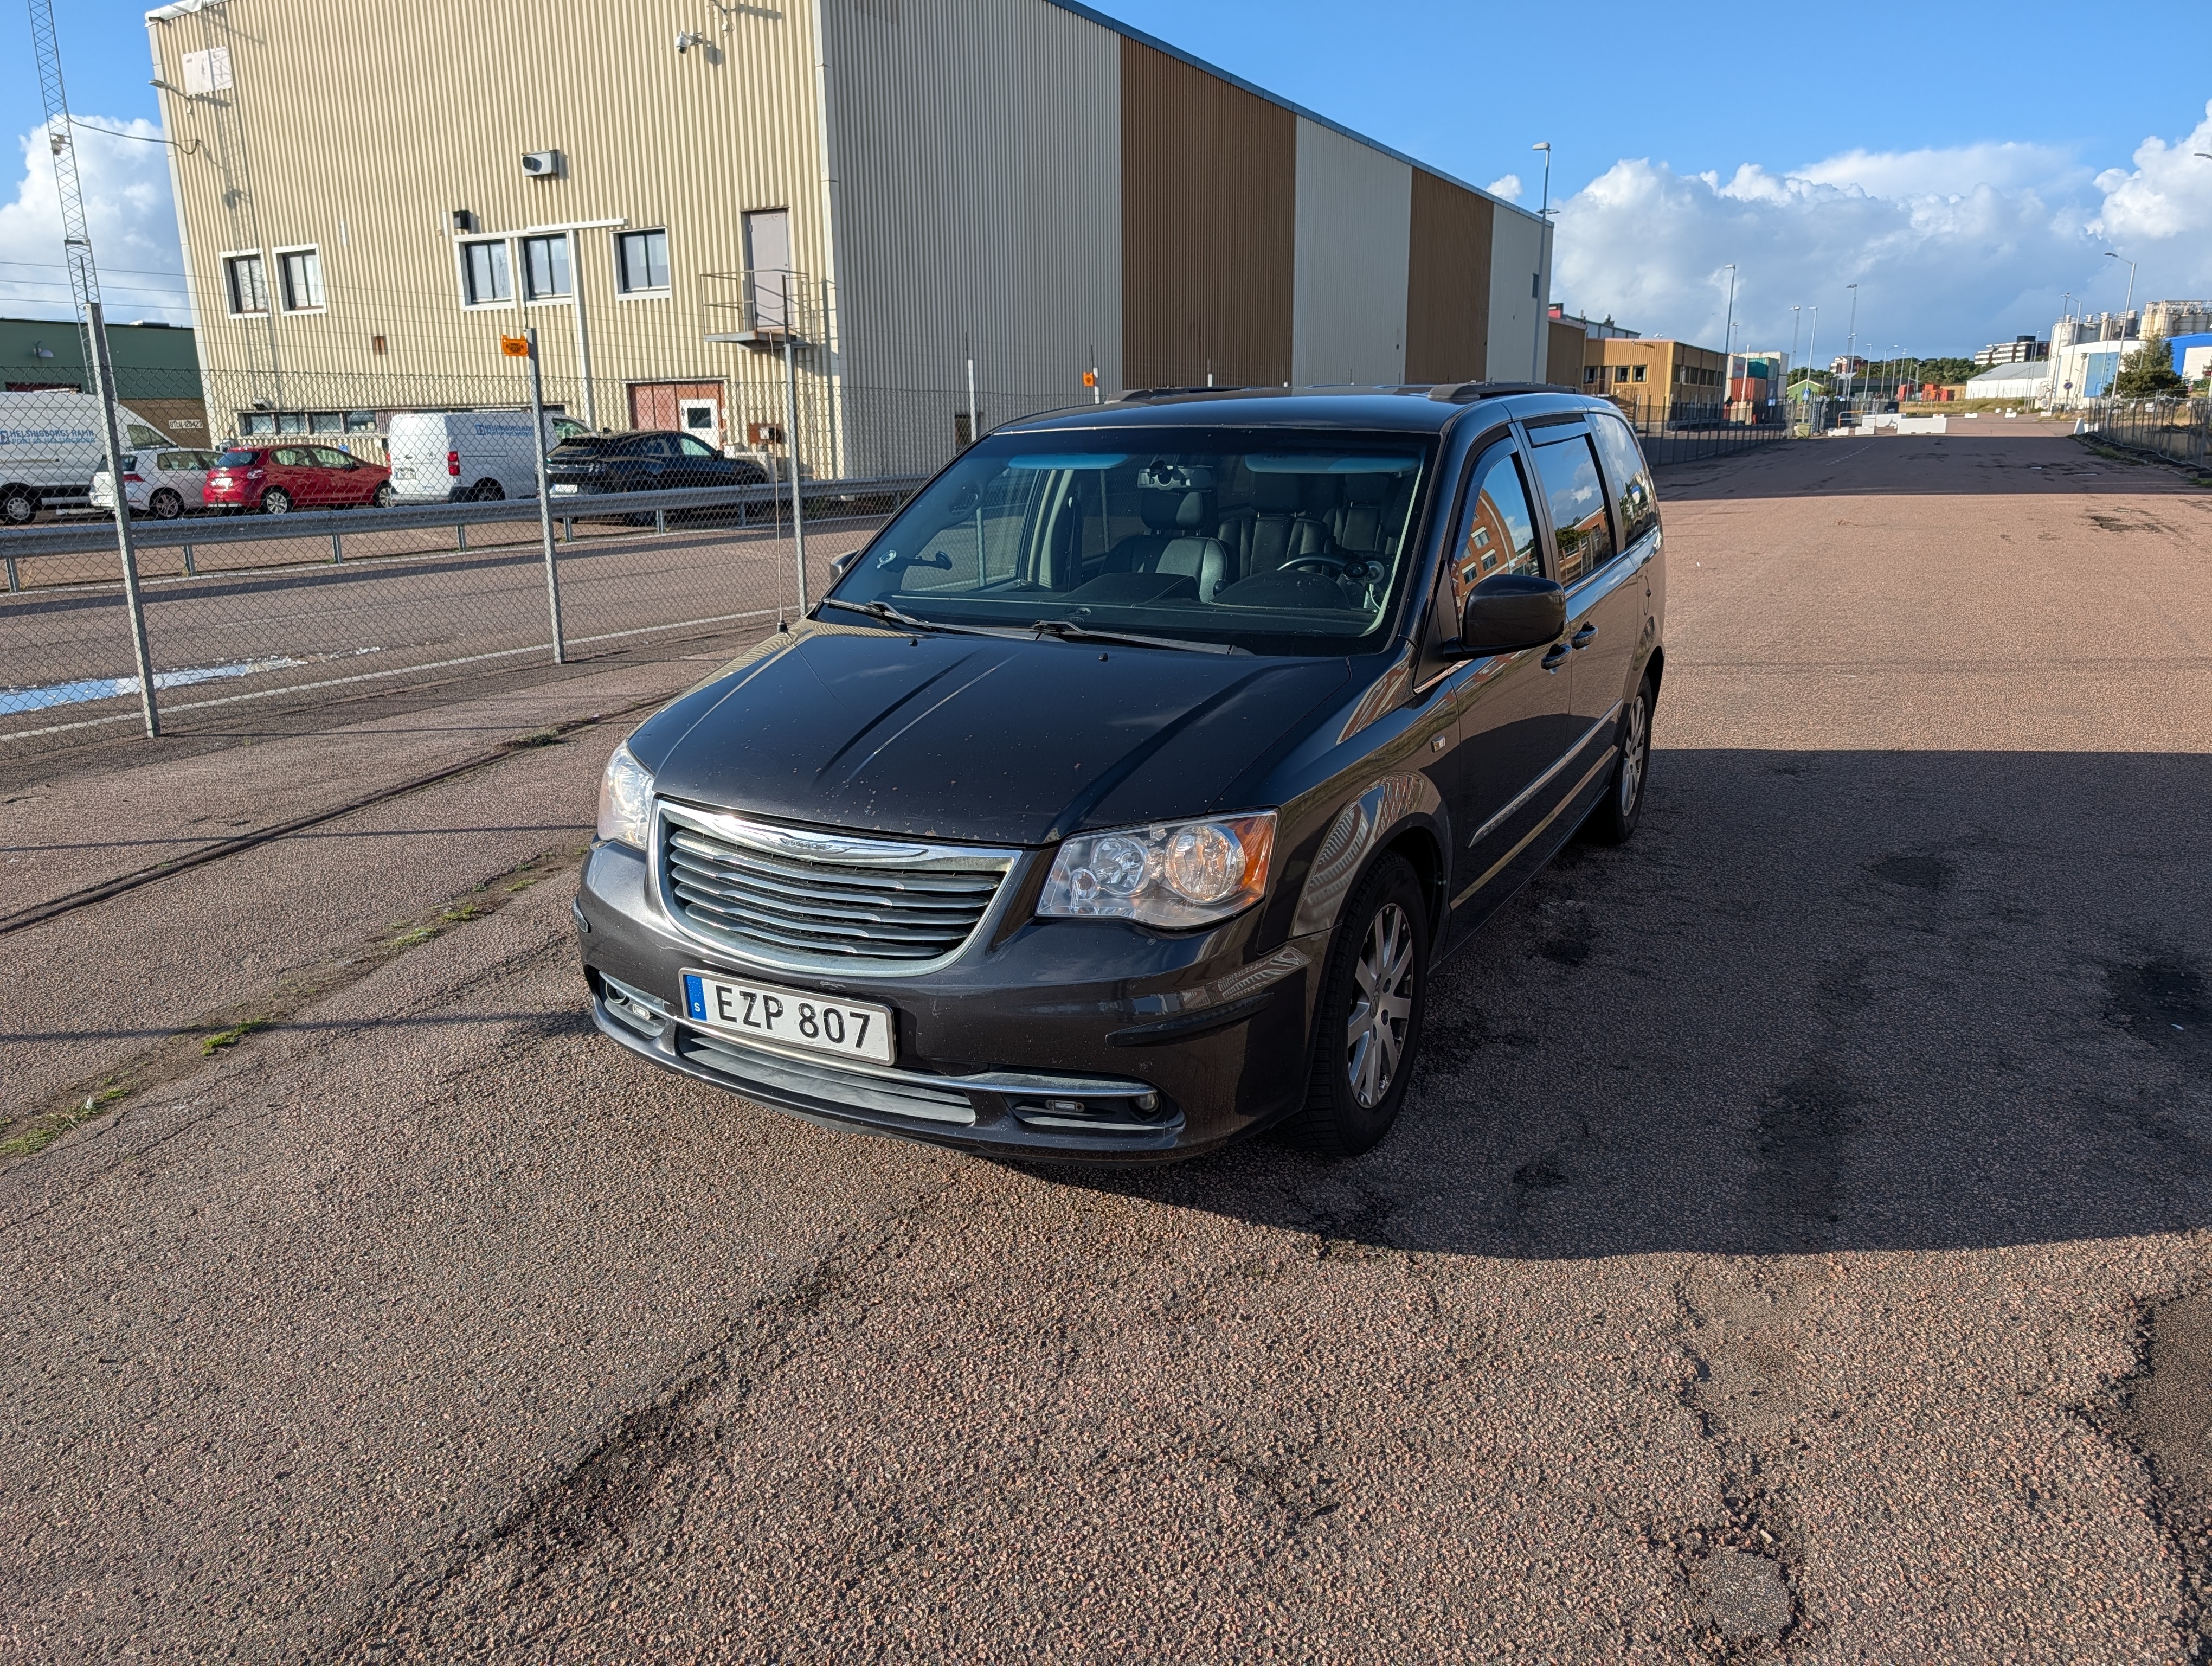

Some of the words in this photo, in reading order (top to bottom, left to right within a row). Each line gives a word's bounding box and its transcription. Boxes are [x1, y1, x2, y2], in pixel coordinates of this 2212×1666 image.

[694, 1002, 701, 1013] S
[716, 985, 785, 1030] EZP
[798, 1002, 871, 1048] 807
